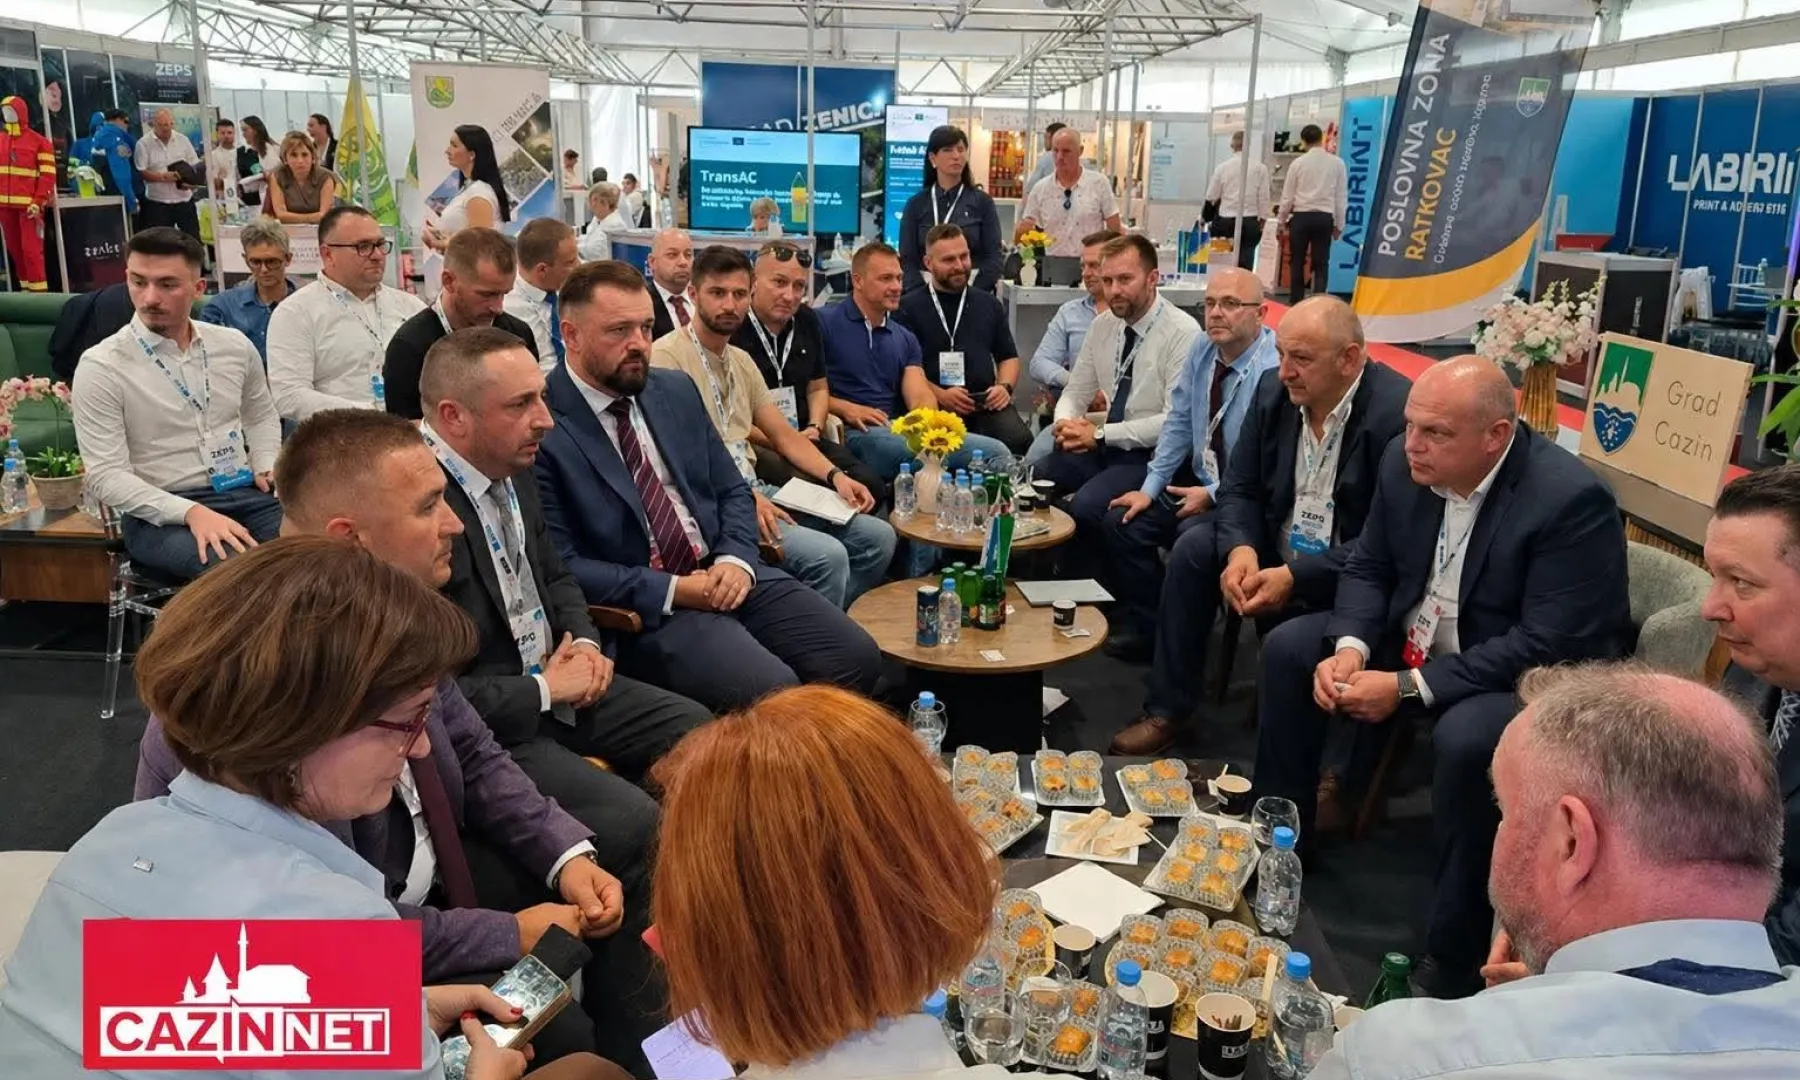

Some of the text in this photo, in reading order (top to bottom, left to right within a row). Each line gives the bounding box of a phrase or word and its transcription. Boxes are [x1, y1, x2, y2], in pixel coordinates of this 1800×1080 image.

[155, 62, 192, 77] ZEPS
[1378, 33, 1450, 257] POSLOVNA ZONA
[700, 170, 757, 184] TransAC
[1339, 117, 1372, 270] LABIRINT
[1405, 127, 1457, 261] RATKOVAC
[1693, 198, 1719, 211] PRINT
[1667, 380, 1721, 417] Grad
[1655, 420, 1712, 461] Cazin
